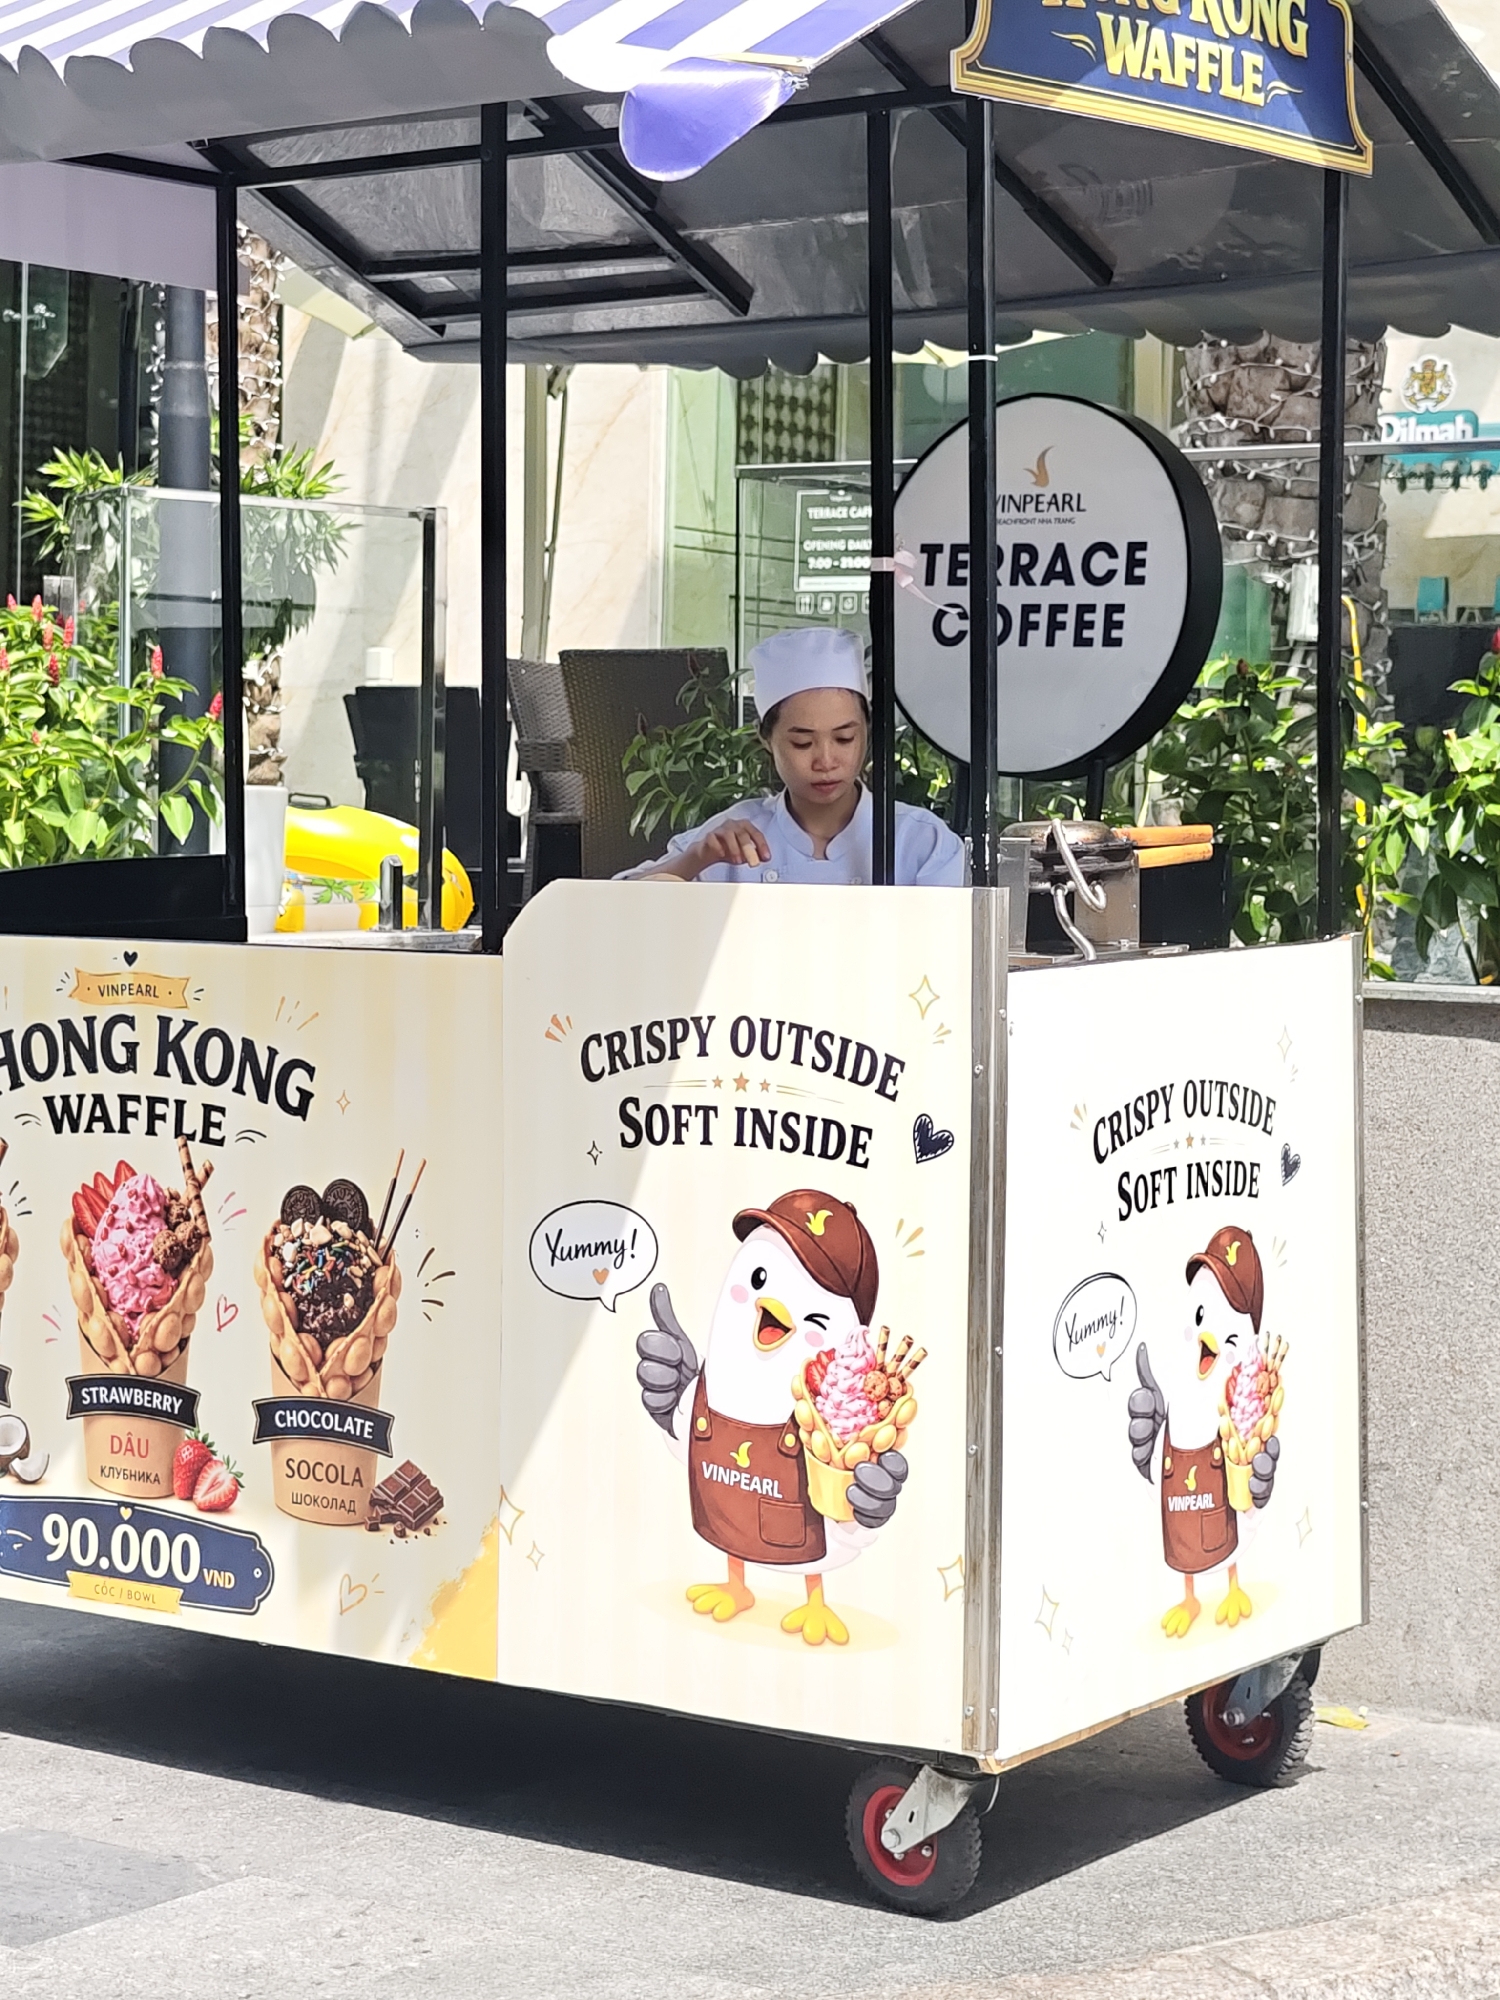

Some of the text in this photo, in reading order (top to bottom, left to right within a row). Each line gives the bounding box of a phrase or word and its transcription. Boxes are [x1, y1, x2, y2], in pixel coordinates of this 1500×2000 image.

[1096, 11, 1265, 107] WAFFLE
[1378, 414, 1474, 442] Dilmah
[996, 492, 1087, 513] INPEARL
[997, 517, 1036, 526] EACHFRONT
[98, 982, 160, 999] VINPEARL
[154, 1014, 316, 1122] KONG
[580, 1014, 906, 1103] CRISPY OUTSIDE
[43, 1093, 227, 1148] WAFFLE
[618, 1096, 874, 1169] SOFT INSIDE
[1093, 1079, 1277, 1165] CRISPY OUTSIDE
[1117, 1160, 1261, 1222] SOFT INSIDE
[545, 1228, 638, 1270] Yummy!
[1065, 1295, 1125, 1353] Yummy!
[81, 1386, 183, 1416] STRAWBERRY
[274, 1409, 375, 1440] CHOCOLATE
[110, 1432, 150, 1459] DÂU
[100, 1465, 161, 1485] КЛУБНИКА
[285, 1457, 364, 1488] SOCOLA
[701, 1461, 783, 1499] VINPEARL
[291, 1491, 357, 1516] ШОКОЛАД
[1167, 1493, 1215, 1512] VINPEARL
[42, 1513, 235, 1590] 90.000 VND
[127, 1589, 156, 1605] BOWL
